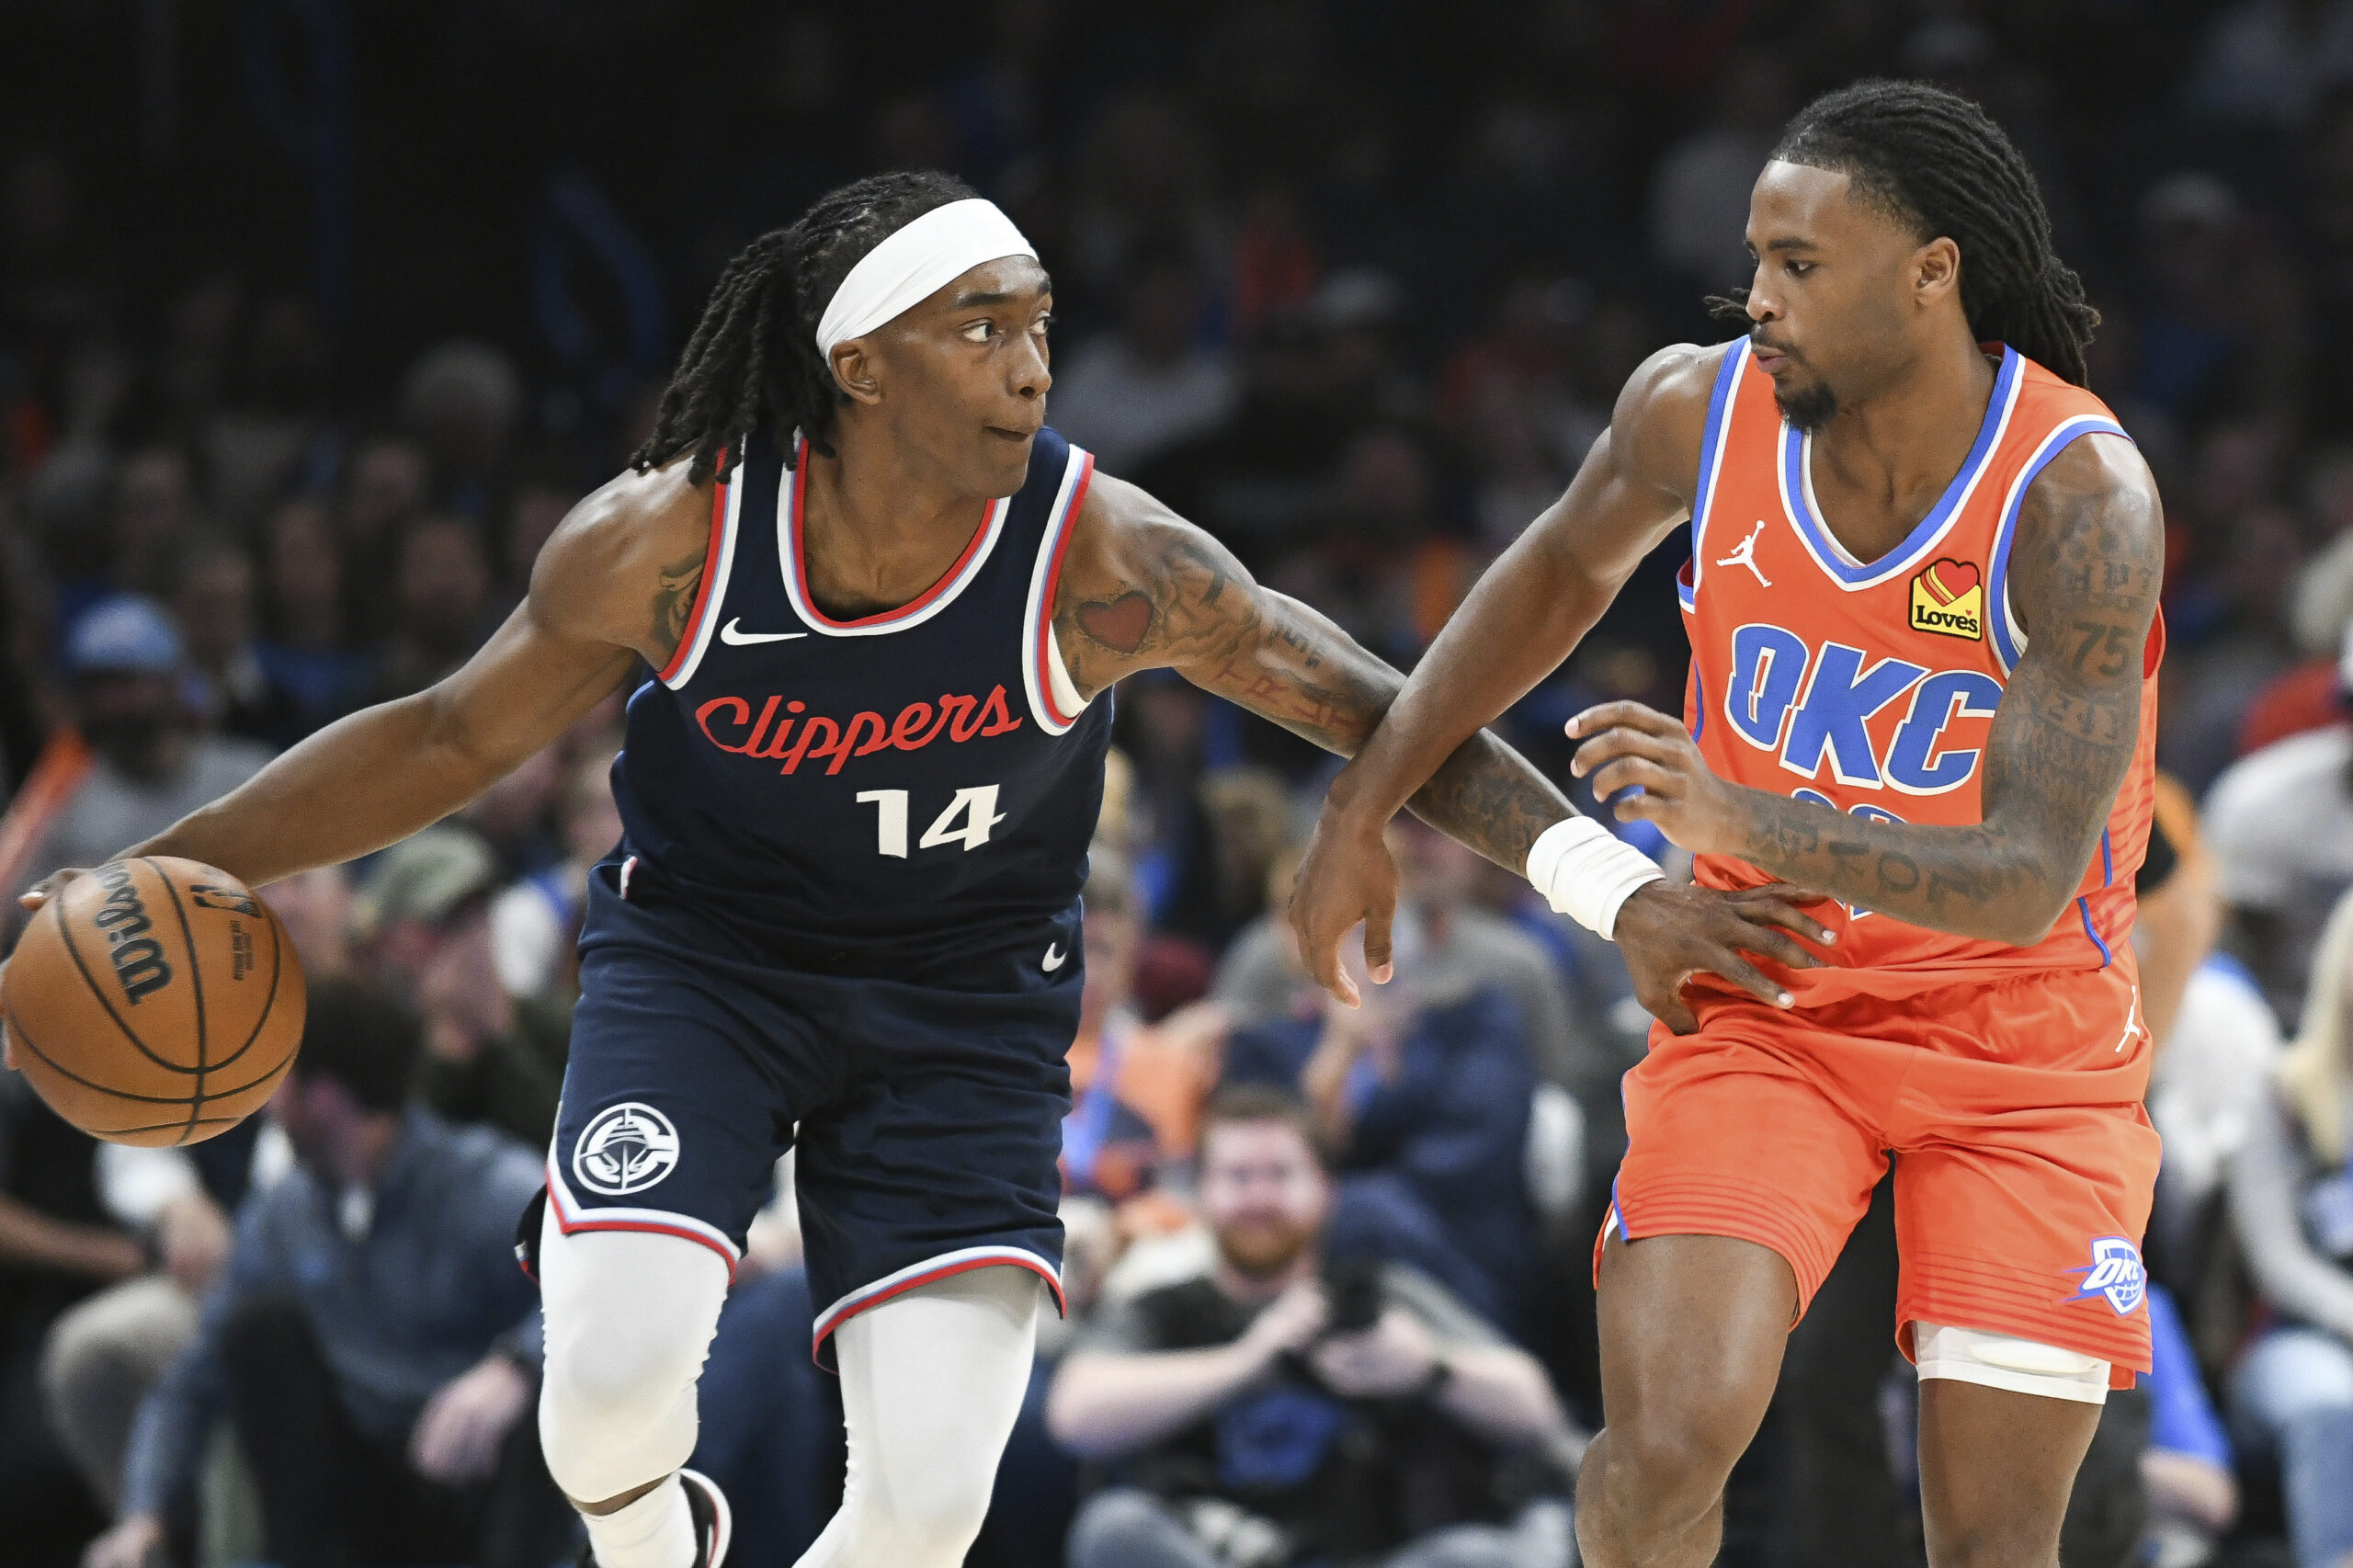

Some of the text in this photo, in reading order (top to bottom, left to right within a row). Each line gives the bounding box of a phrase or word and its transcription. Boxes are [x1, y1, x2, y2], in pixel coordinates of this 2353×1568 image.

[695, 684, 1023, 775] Clippers
[1724, 623, 2003, 796] OKC
[856, 783, 1007, 858] 14
[94, 861, 174, 1006] Wilson
